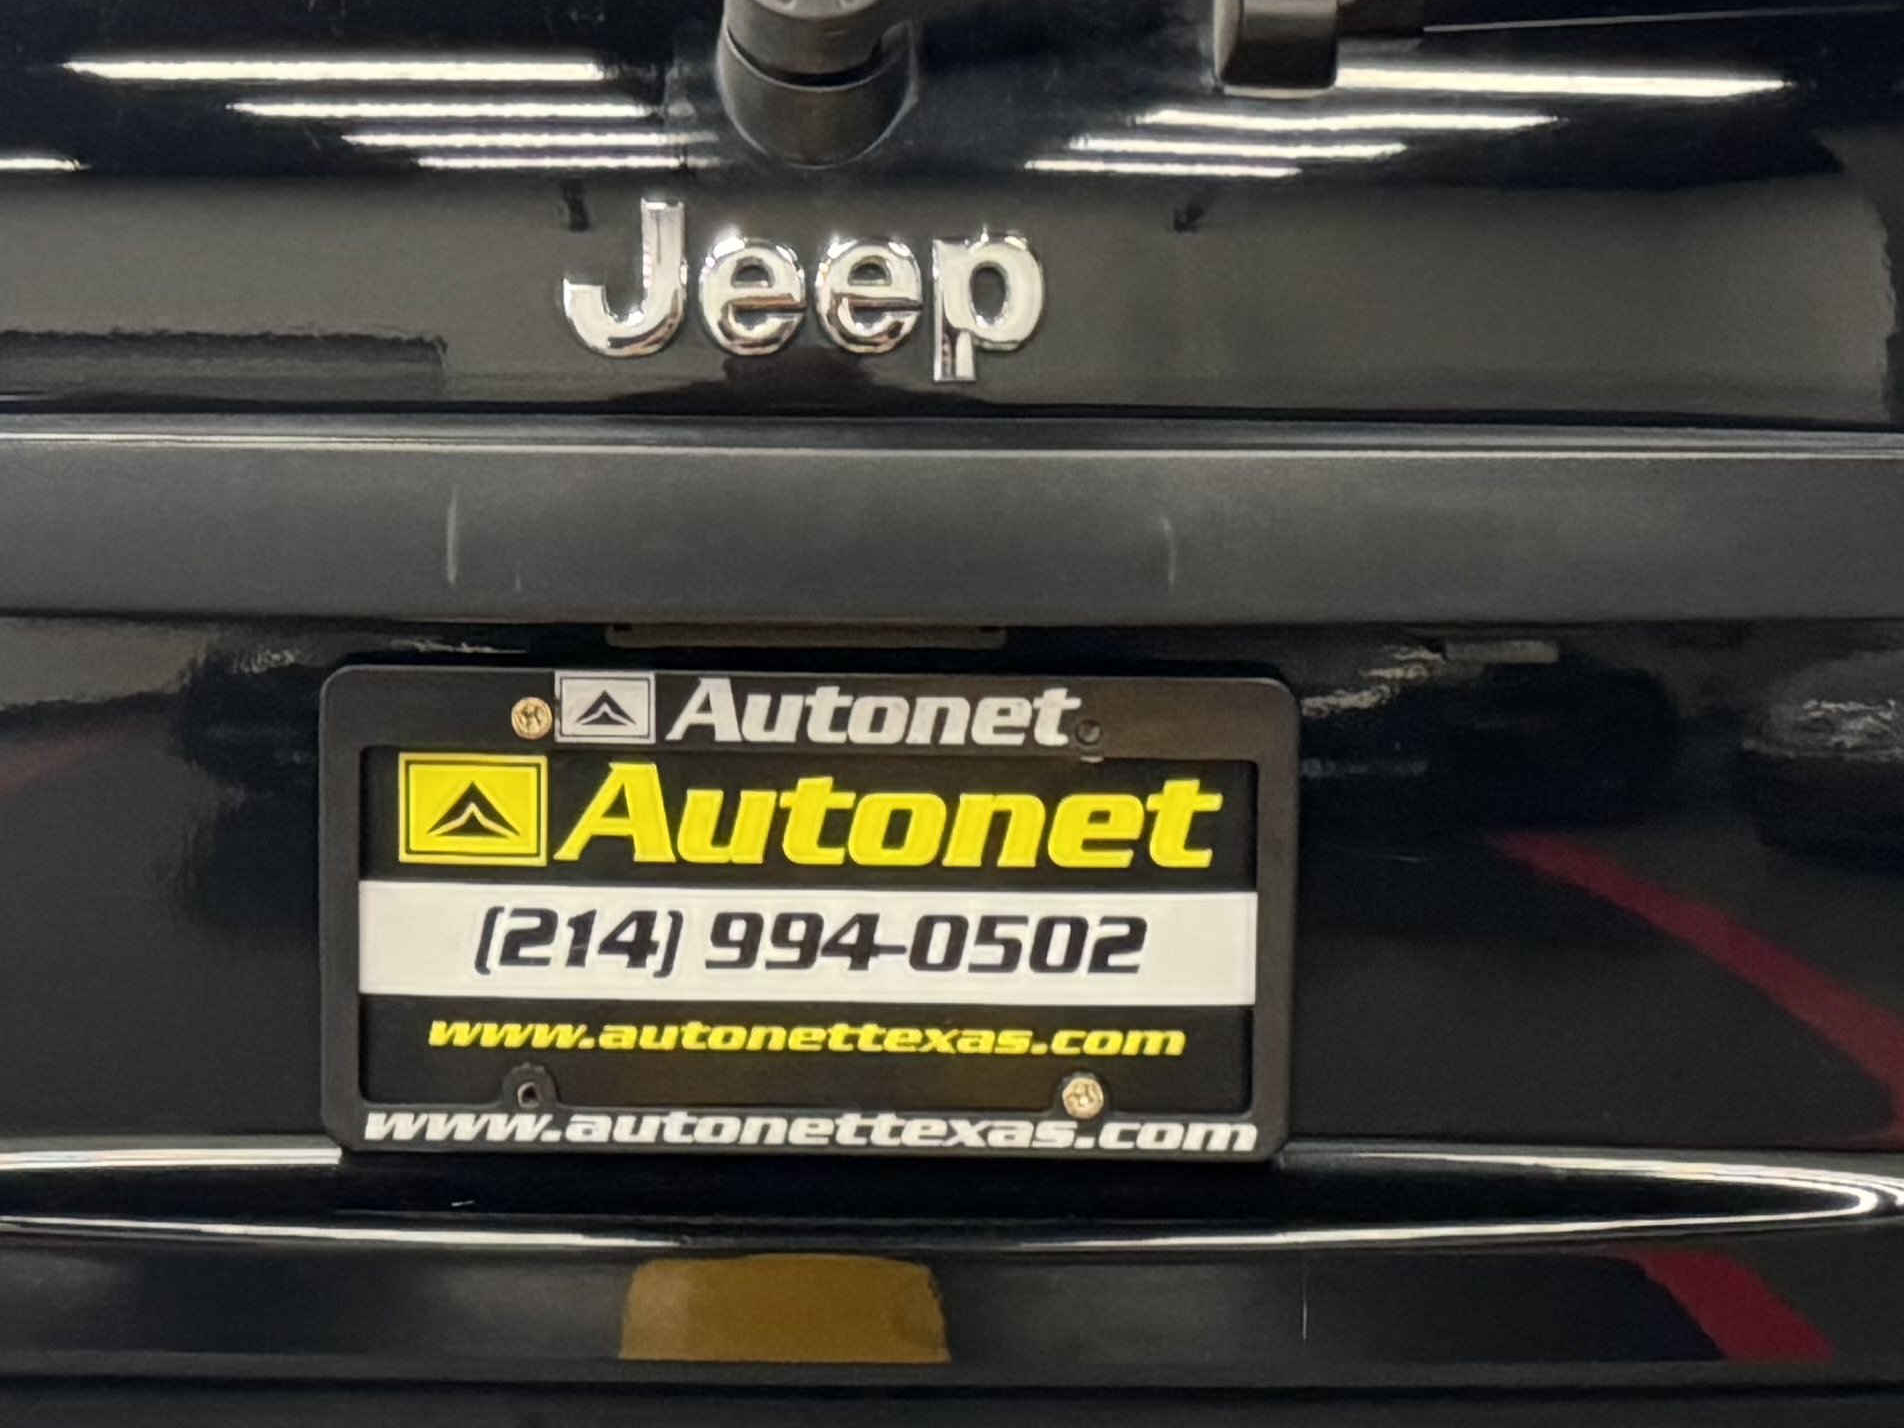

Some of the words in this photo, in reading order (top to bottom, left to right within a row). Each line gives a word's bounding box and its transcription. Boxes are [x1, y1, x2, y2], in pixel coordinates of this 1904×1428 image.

[562, 196, 1044, 383] Jeep
[664, 676, 1082, 746] Autonet
[553, 761, 1224, 869] Autonet
[474, 906, 684, 978] (214)
[704, 912, 1149, 975] 994-0502
[427, 1019, 1187, 1058] www.autonettexas.com
[363, 1108, 1259, 1153] www.autonettexas.com
